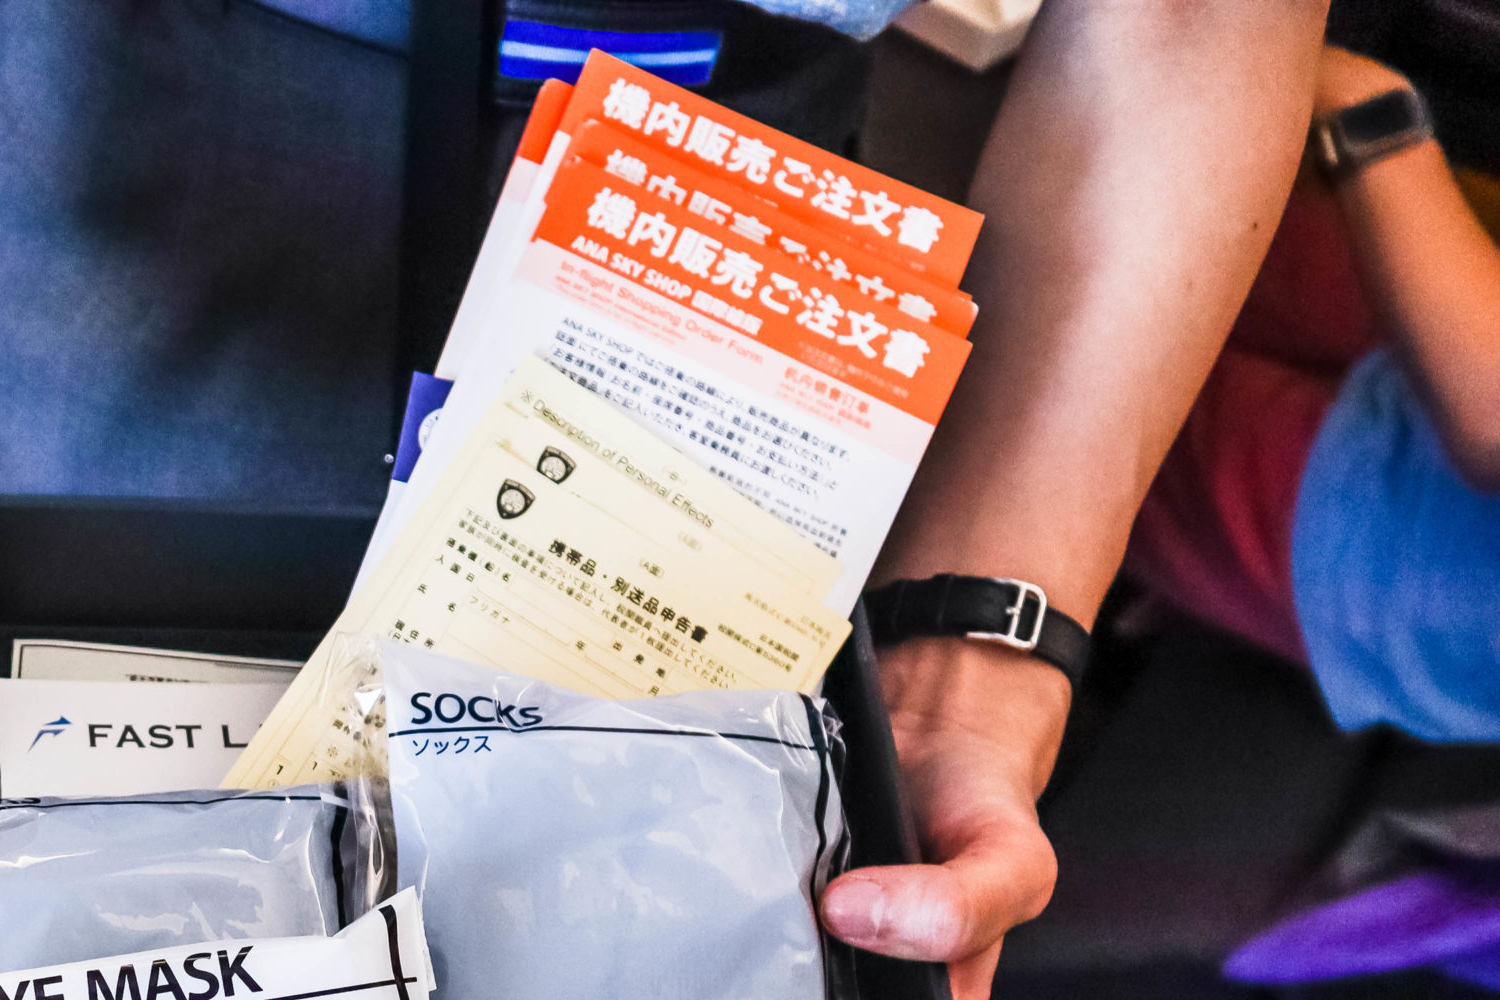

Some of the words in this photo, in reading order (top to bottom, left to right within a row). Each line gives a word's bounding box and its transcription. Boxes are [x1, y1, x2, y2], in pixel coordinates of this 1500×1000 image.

[603, 78, 943, 253] 機内販売ご注文書
[571, 235, 609, 262] ANA
[610, 252, 645, 278] SKY
[643, 268, 693, 300] SHOP
[586, 187, 932, 378] 機内販売ご注文書
[617, 455, 671, 497] Personal
[672, 493, 714, 530] Effects
[88, 724, 203, 748] FAST
[411, 692, 543, 728] SOCKS
[411, 735, 493, 756] ソックス
